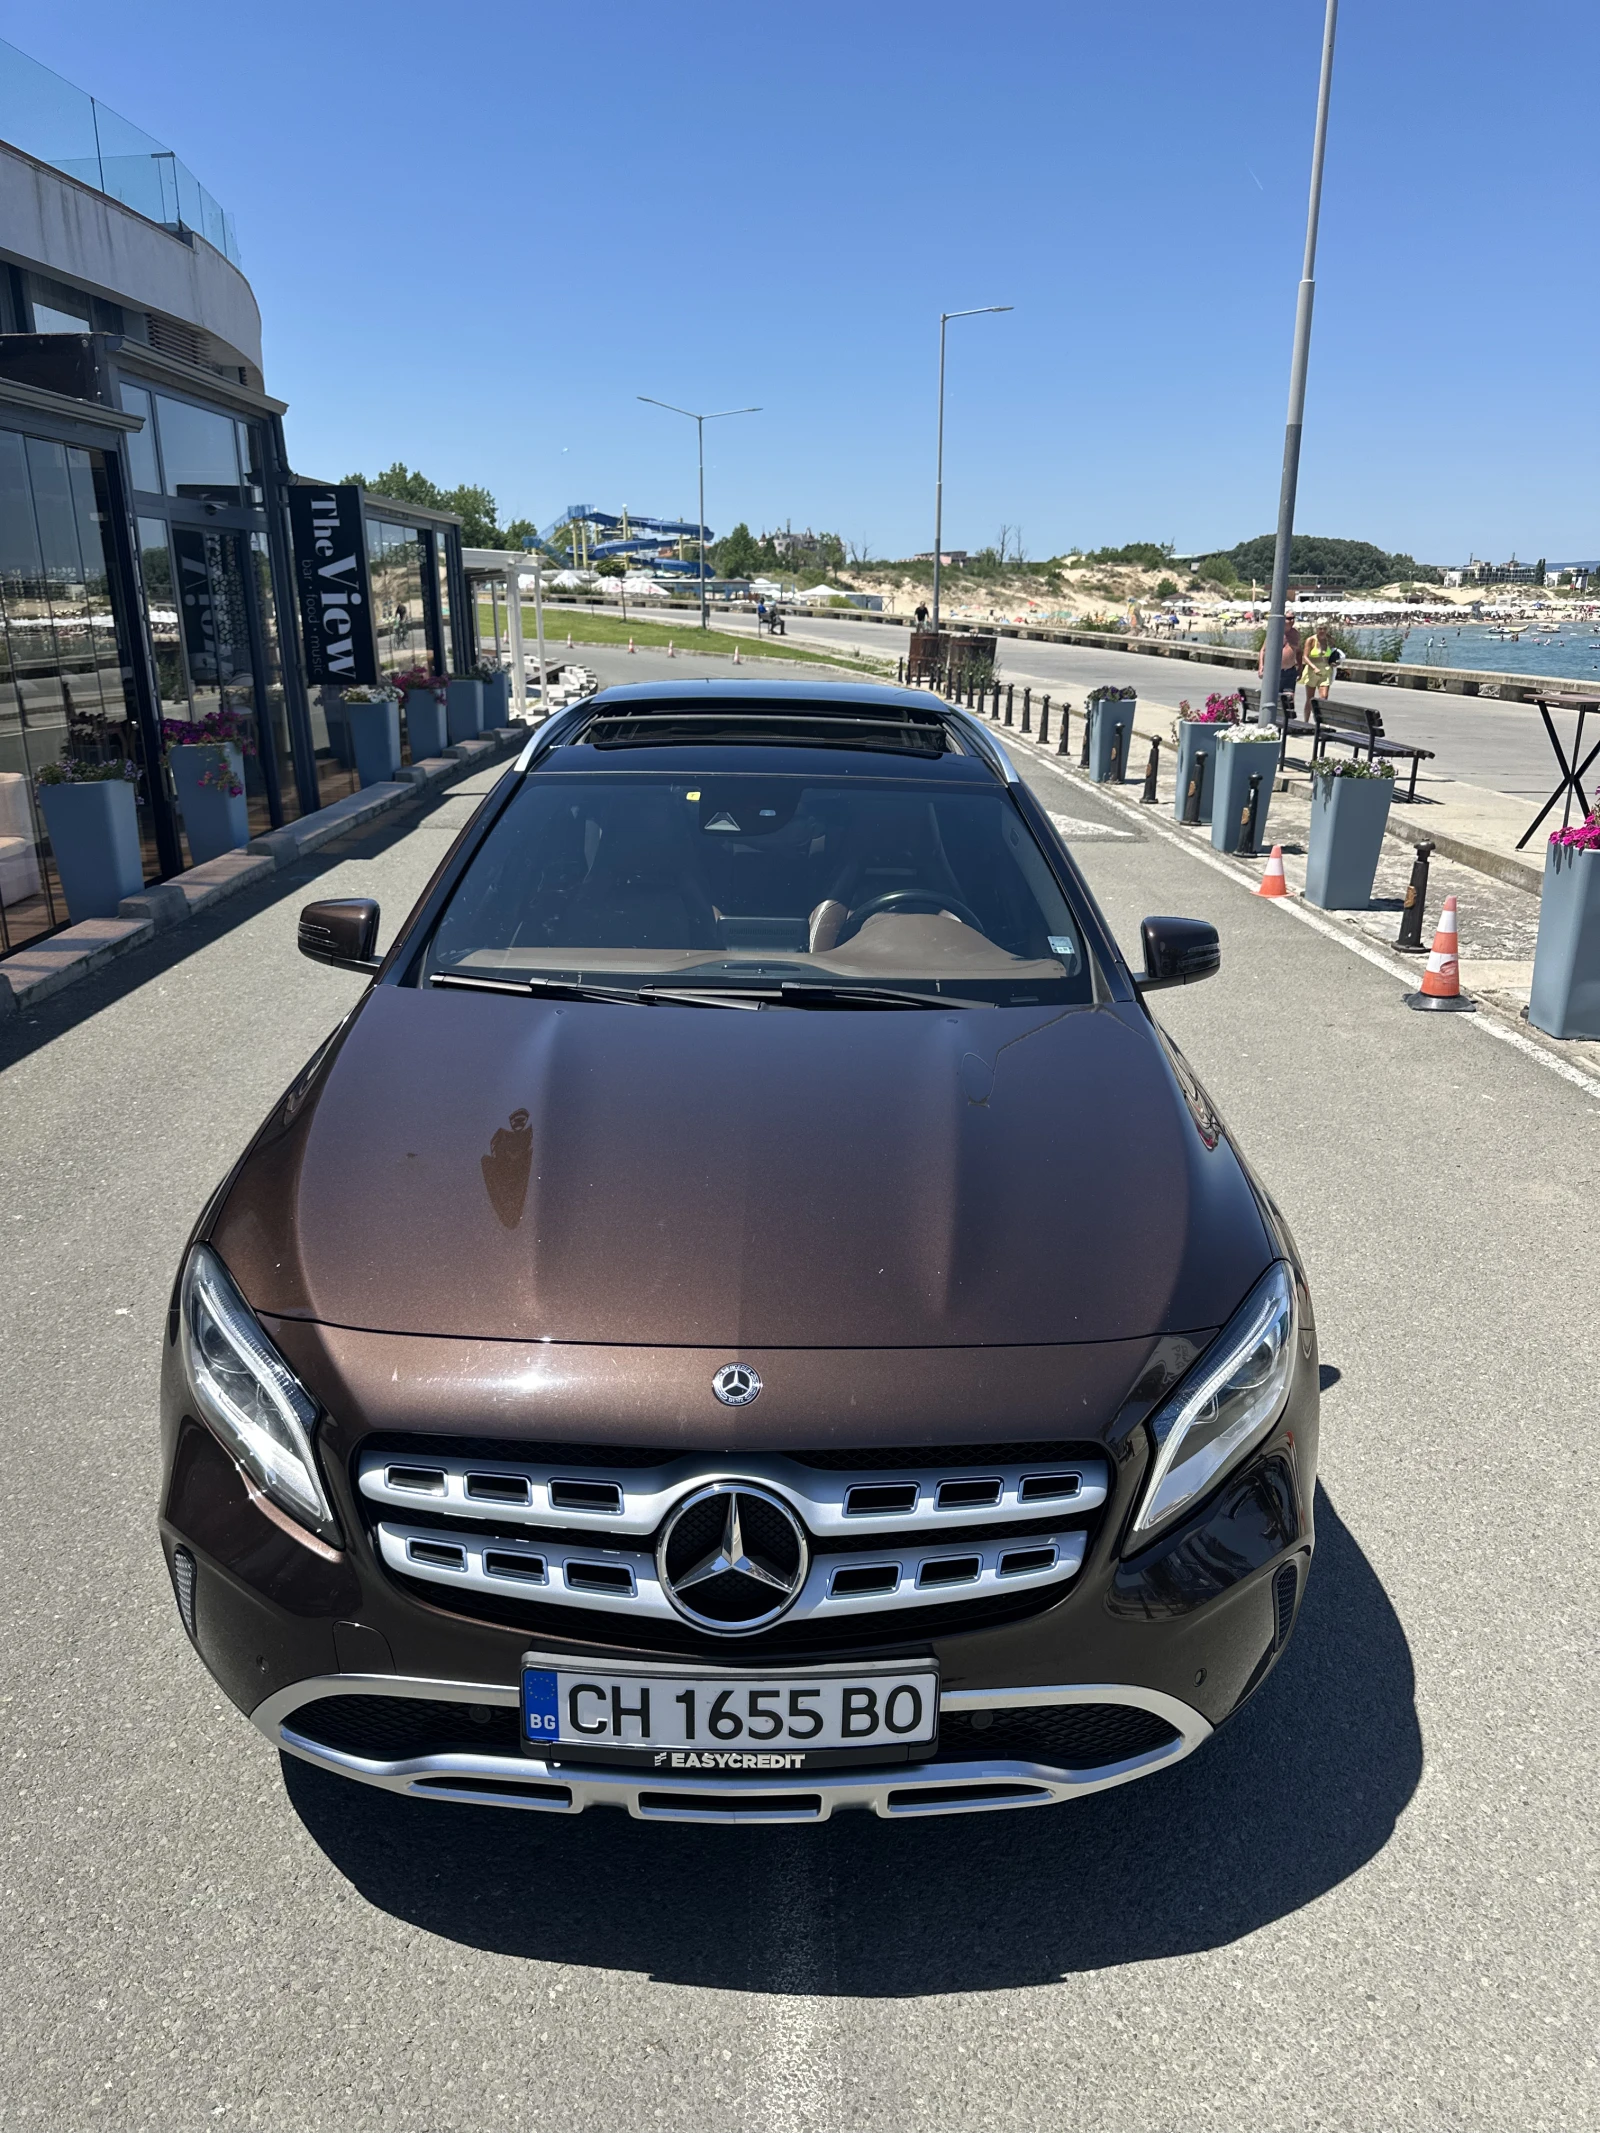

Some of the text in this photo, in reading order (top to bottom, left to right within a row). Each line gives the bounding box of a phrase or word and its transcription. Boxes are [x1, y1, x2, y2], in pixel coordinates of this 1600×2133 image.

[310, 493, 362, 679] The View
[302, 559, 324, 675] bar food music
[530, 1713, 556, 1731] BG
[568, 1683, 922, 1741] CH 1655 BO
[671, 1752, 806, 1769] EASYCREDIT
